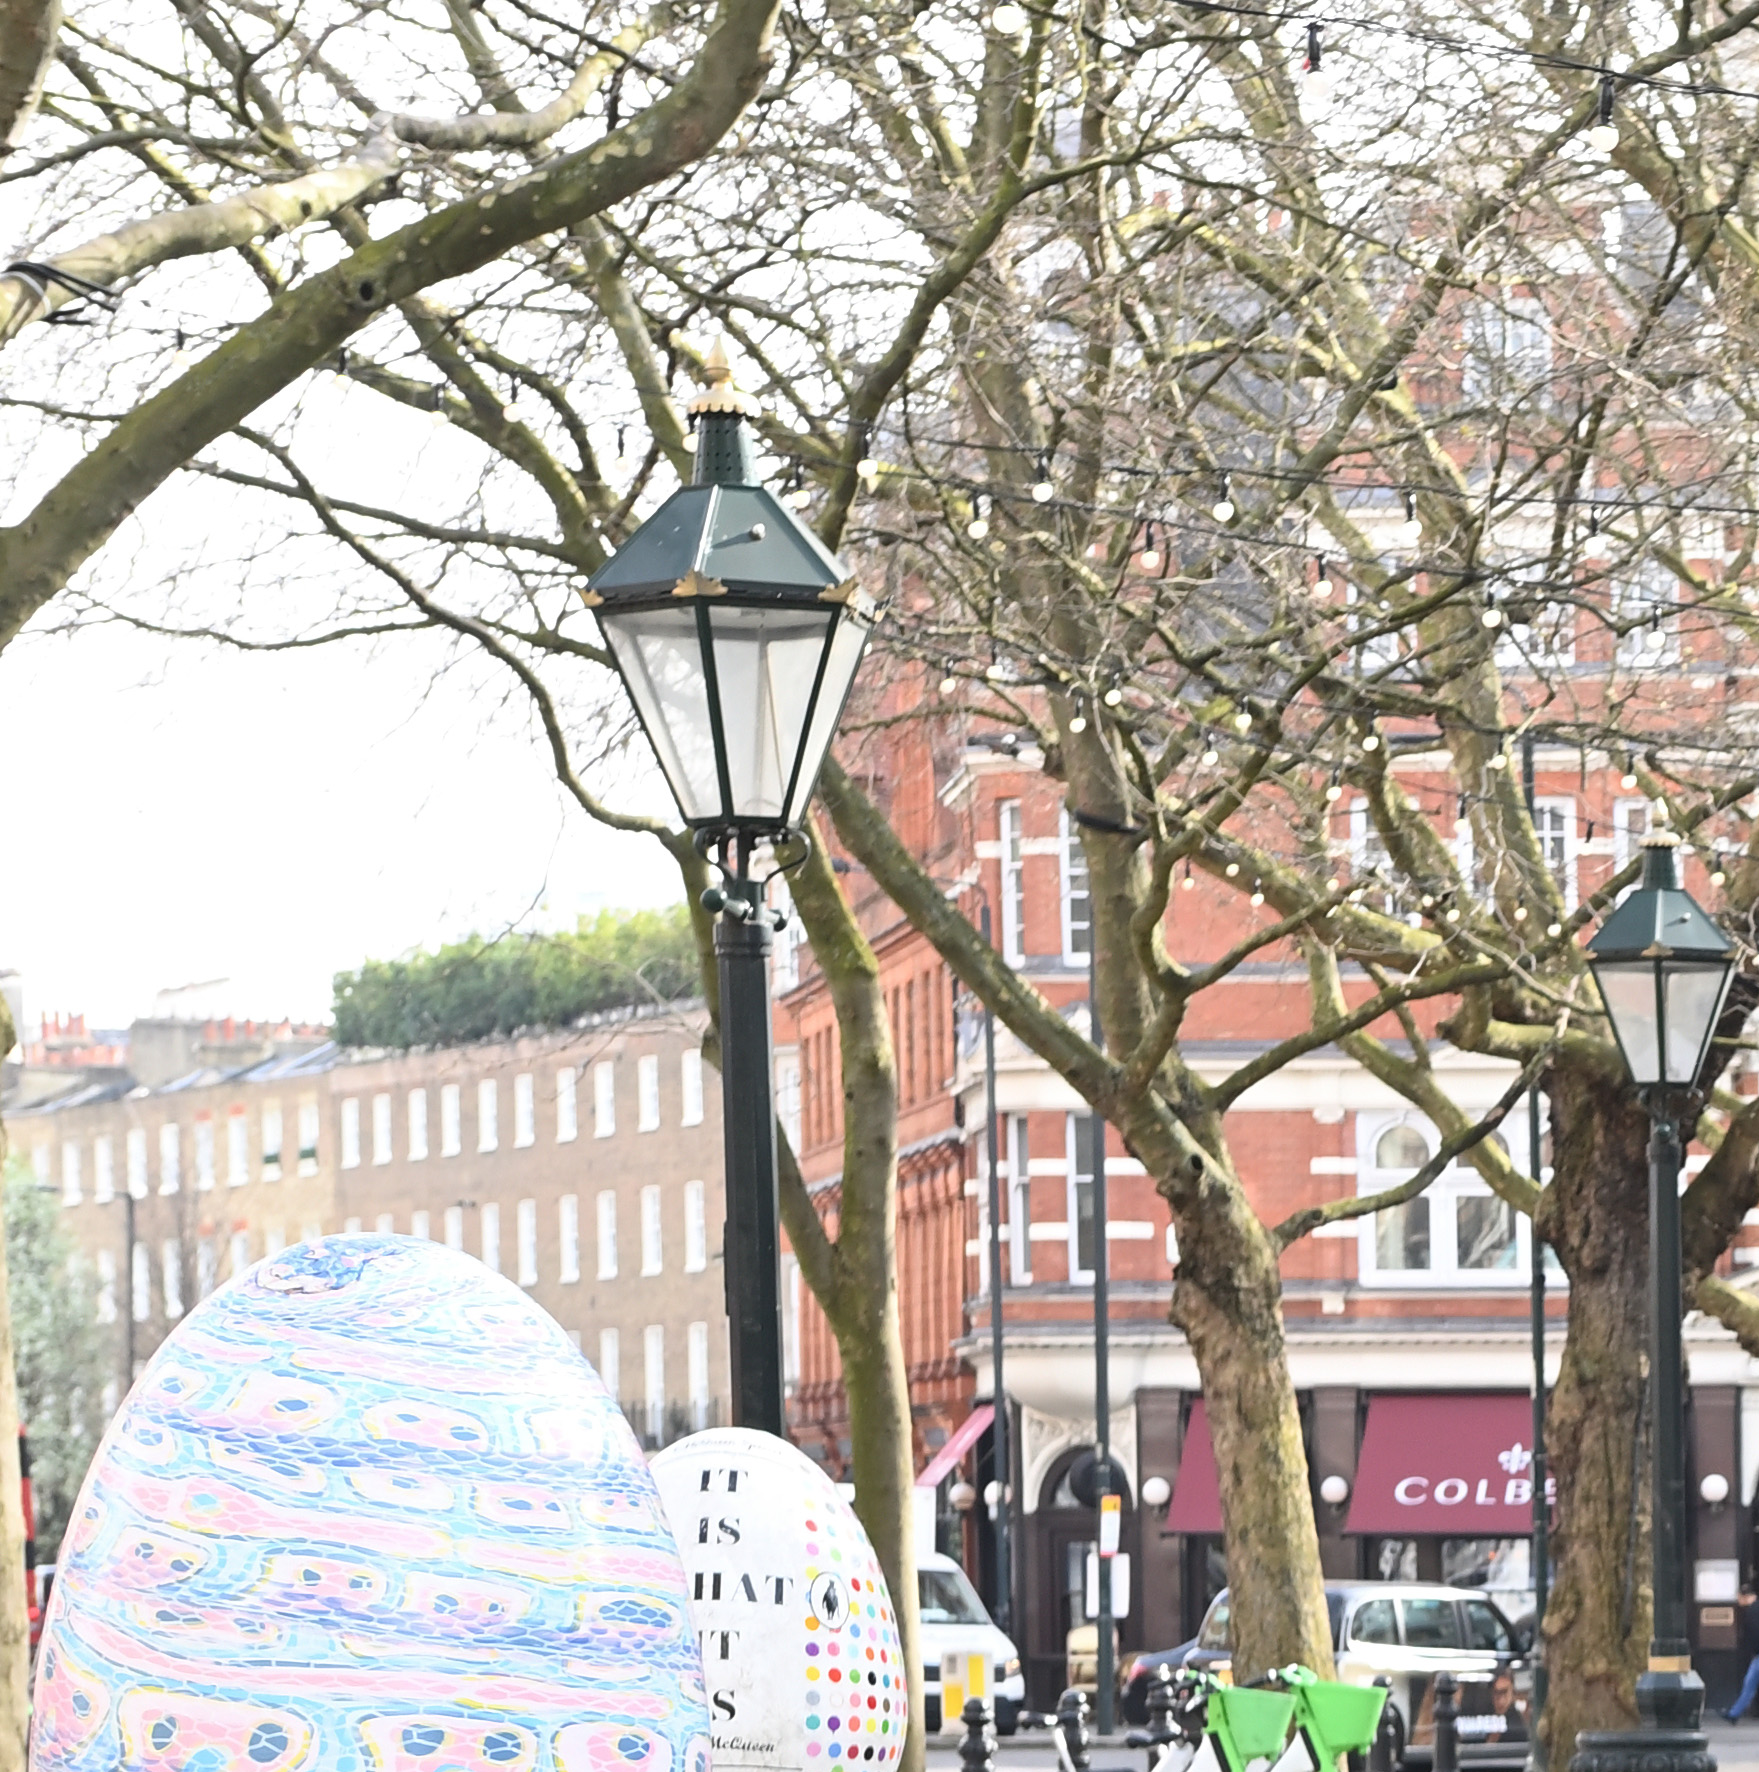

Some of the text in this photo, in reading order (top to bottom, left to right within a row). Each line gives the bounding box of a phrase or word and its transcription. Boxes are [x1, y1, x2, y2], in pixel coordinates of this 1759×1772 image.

[699, 1469, 749, 1493] IT
[1393, 1475, 1557, 1506] COLBE
[698, 1517, 741, 1544] IS
[693, 1572, 794, 1605] HAT
